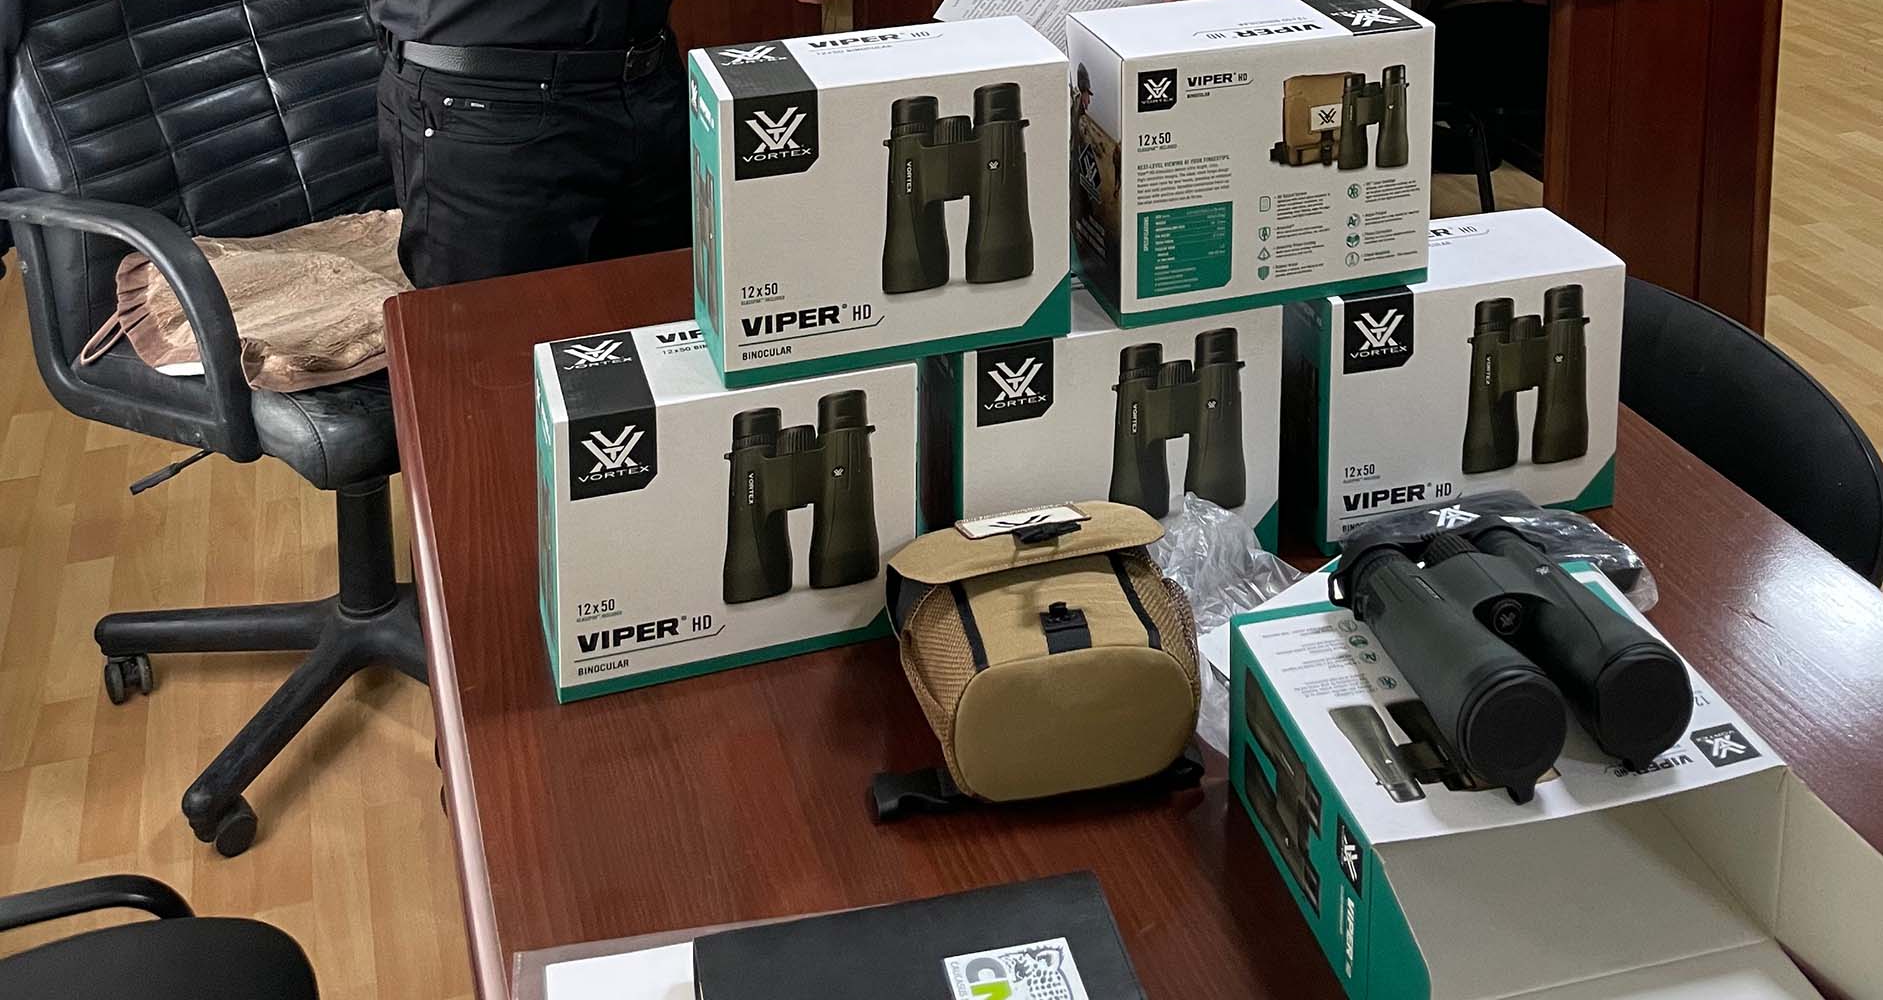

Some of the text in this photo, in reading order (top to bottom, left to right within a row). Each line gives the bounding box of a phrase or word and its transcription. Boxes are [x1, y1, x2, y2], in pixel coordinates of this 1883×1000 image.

[1237, 73, 1248, 82] HD
[1138, 131, 1171, 147] 12x50
[742, 148, 811, 163] VORTEX
[741, 282, 778, 299] 12x50
[852, 304, 872, 321] HD
[742, 346, 792, 361] BINOCULAR
[1349, 345, 1407, 359] VORTEX
[563, 356, 633, 370] VORTEX
[984, 395, 1047, 410] VORTEX
[578, 465, 650, 483] VORTEX
[1344, 464, 1375, 478] 12x50
[1435, 482, 1452, 497] HD
[577, 599, 615, 617] 12x50
[692, 615, 712, 632] HD
[578, 659, 629, 676] BINOCULAR
